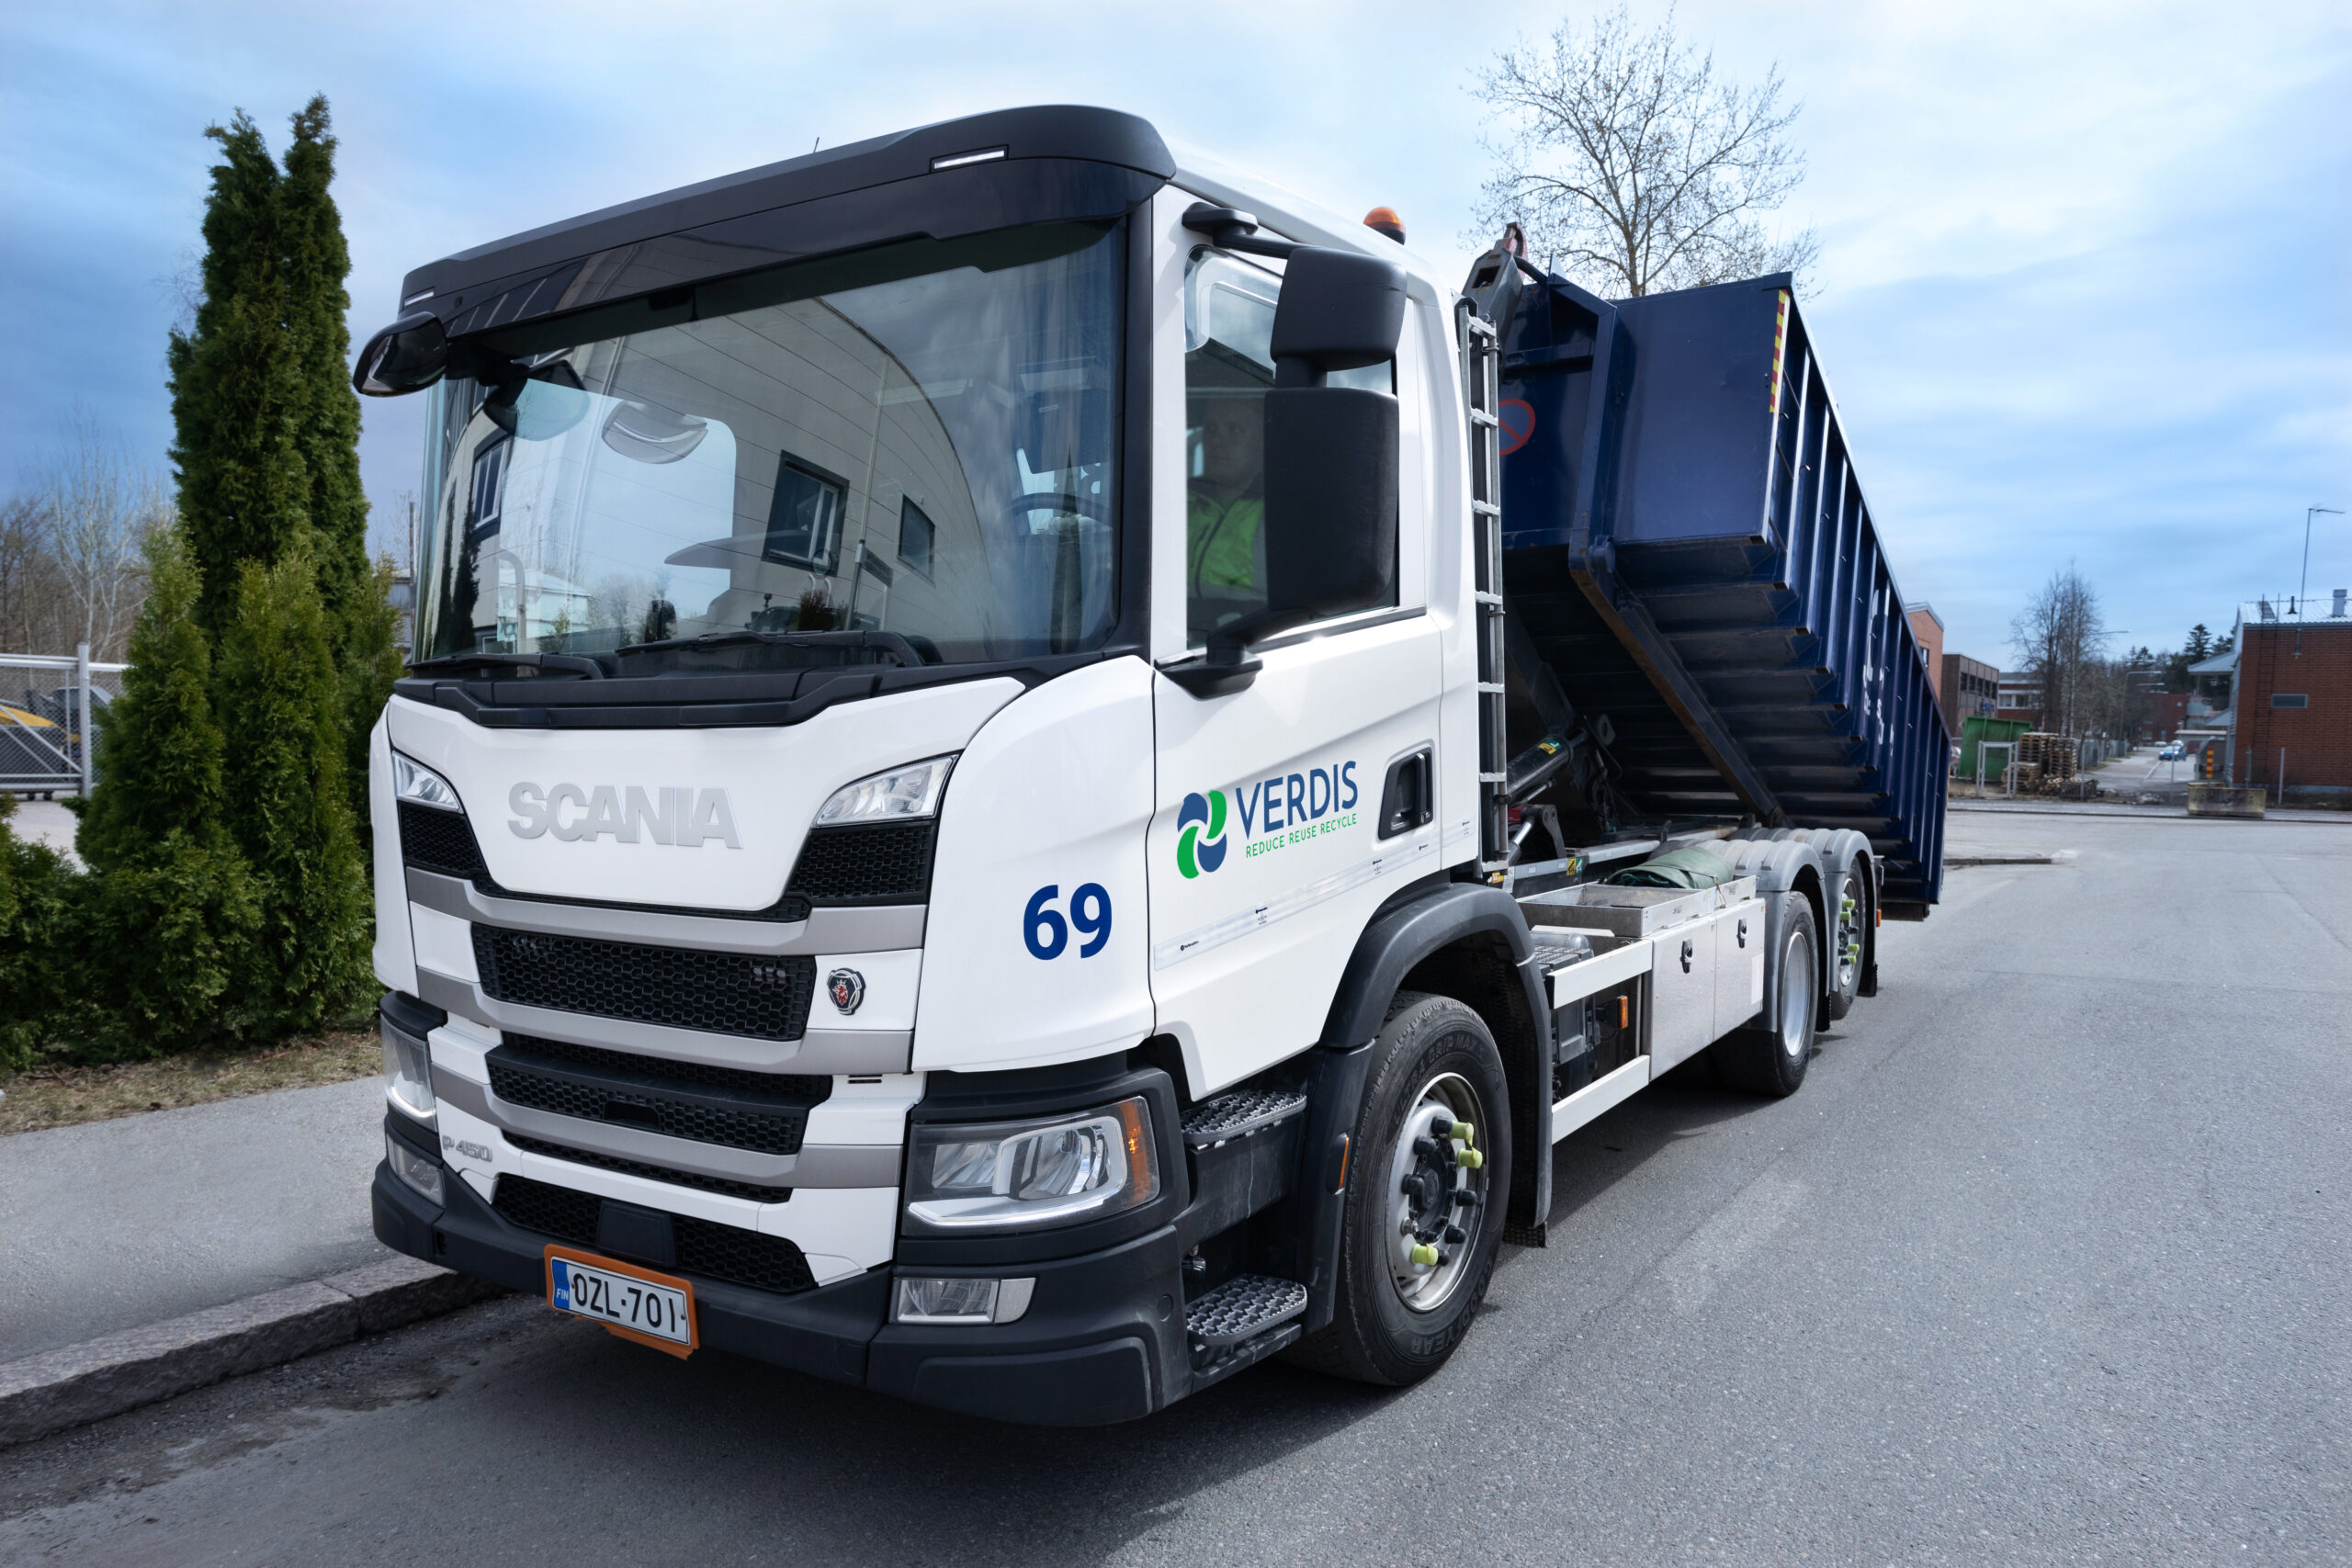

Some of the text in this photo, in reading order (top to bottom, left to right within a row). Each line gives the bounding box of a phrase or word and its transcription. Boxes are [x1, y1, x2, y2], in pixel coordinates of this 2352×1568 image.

[507, 782, 742, 849] SCANIA
[1235, 761, 1358, 840] VERDIS
[1246, 813, 1357, 858] REDUCE REUSE RECYCLE
[1023, 883, 1112, 960] 69
[442, 1134, 492, 1162] P 450
[556, 1288, 569, 1301] FIN
[572, 1272, 675, 1332] OZL-701
